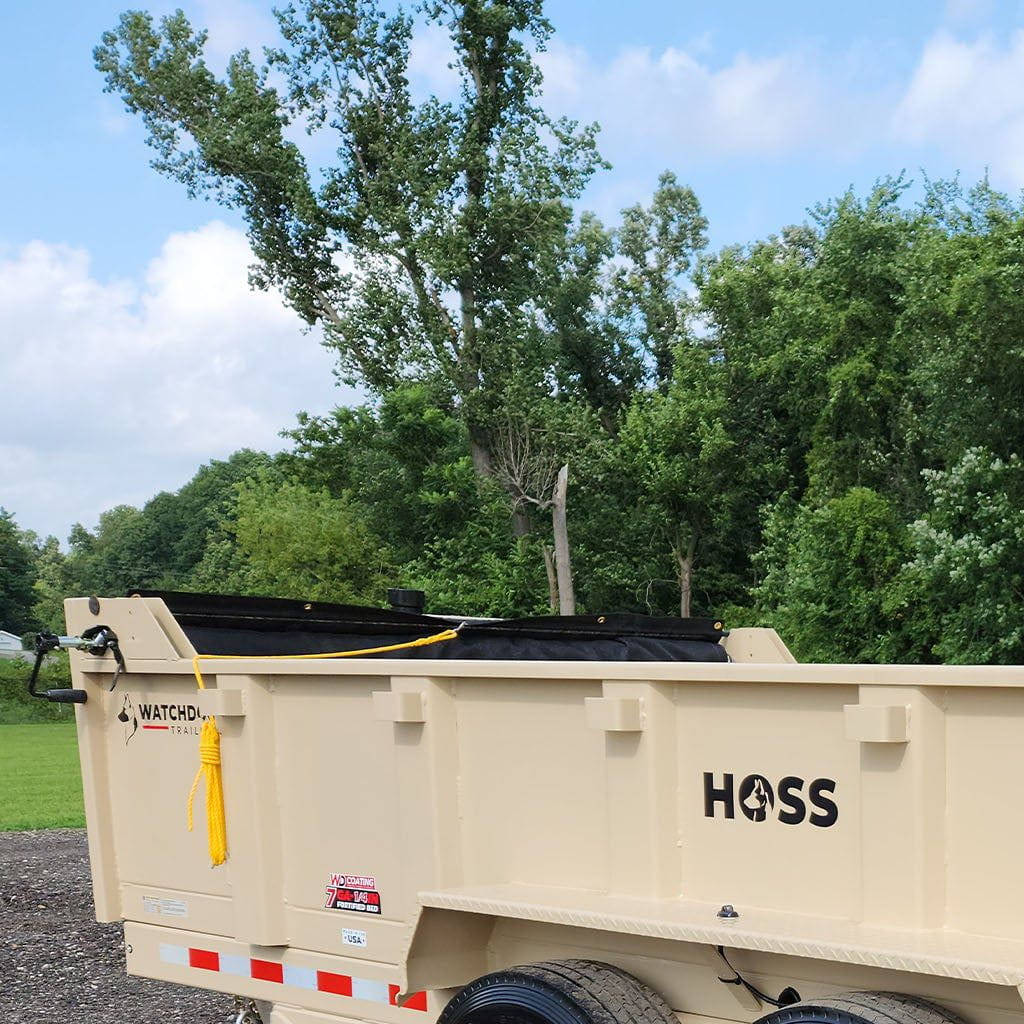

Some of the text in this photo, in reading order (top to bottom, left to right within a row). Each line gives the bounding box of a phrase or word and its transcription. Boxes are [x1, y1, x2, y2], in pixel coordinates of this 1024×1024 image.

[139, 704, 212, 721] WATCHD
[703, 772, 839, 828] HOSS
[346, 876, 375, 887] COATING
[347, 935, 362, 945] USA
